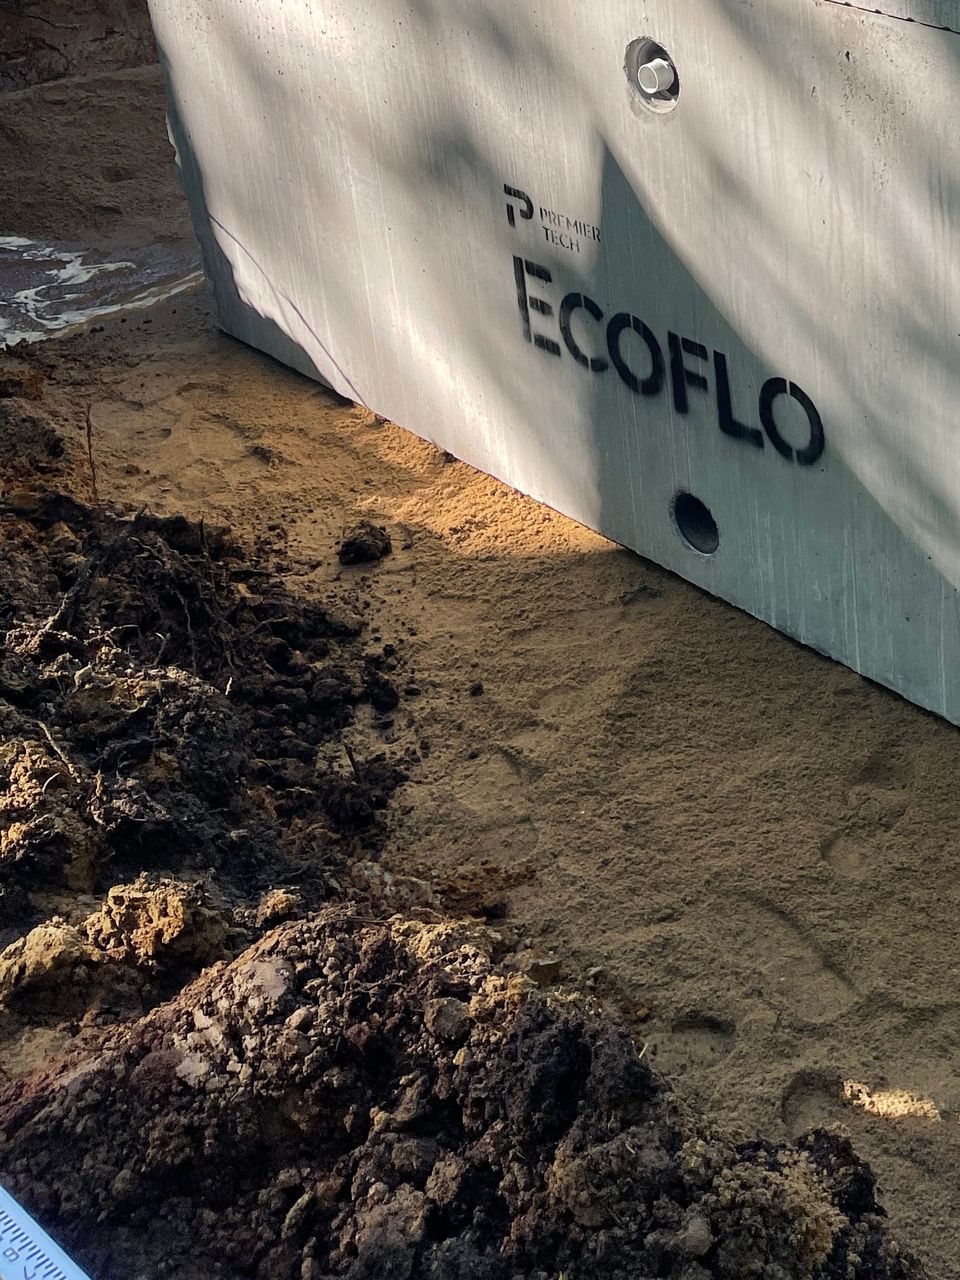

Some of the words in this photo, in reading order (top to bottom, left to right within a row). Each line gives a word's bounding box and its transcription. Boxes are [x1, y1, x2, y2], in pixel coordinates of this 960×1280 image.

[540, 206, 601, 242] PREMIER
[542, 225, 580, 253] TECH
[512, 254, 826, 466] ECOFLO
